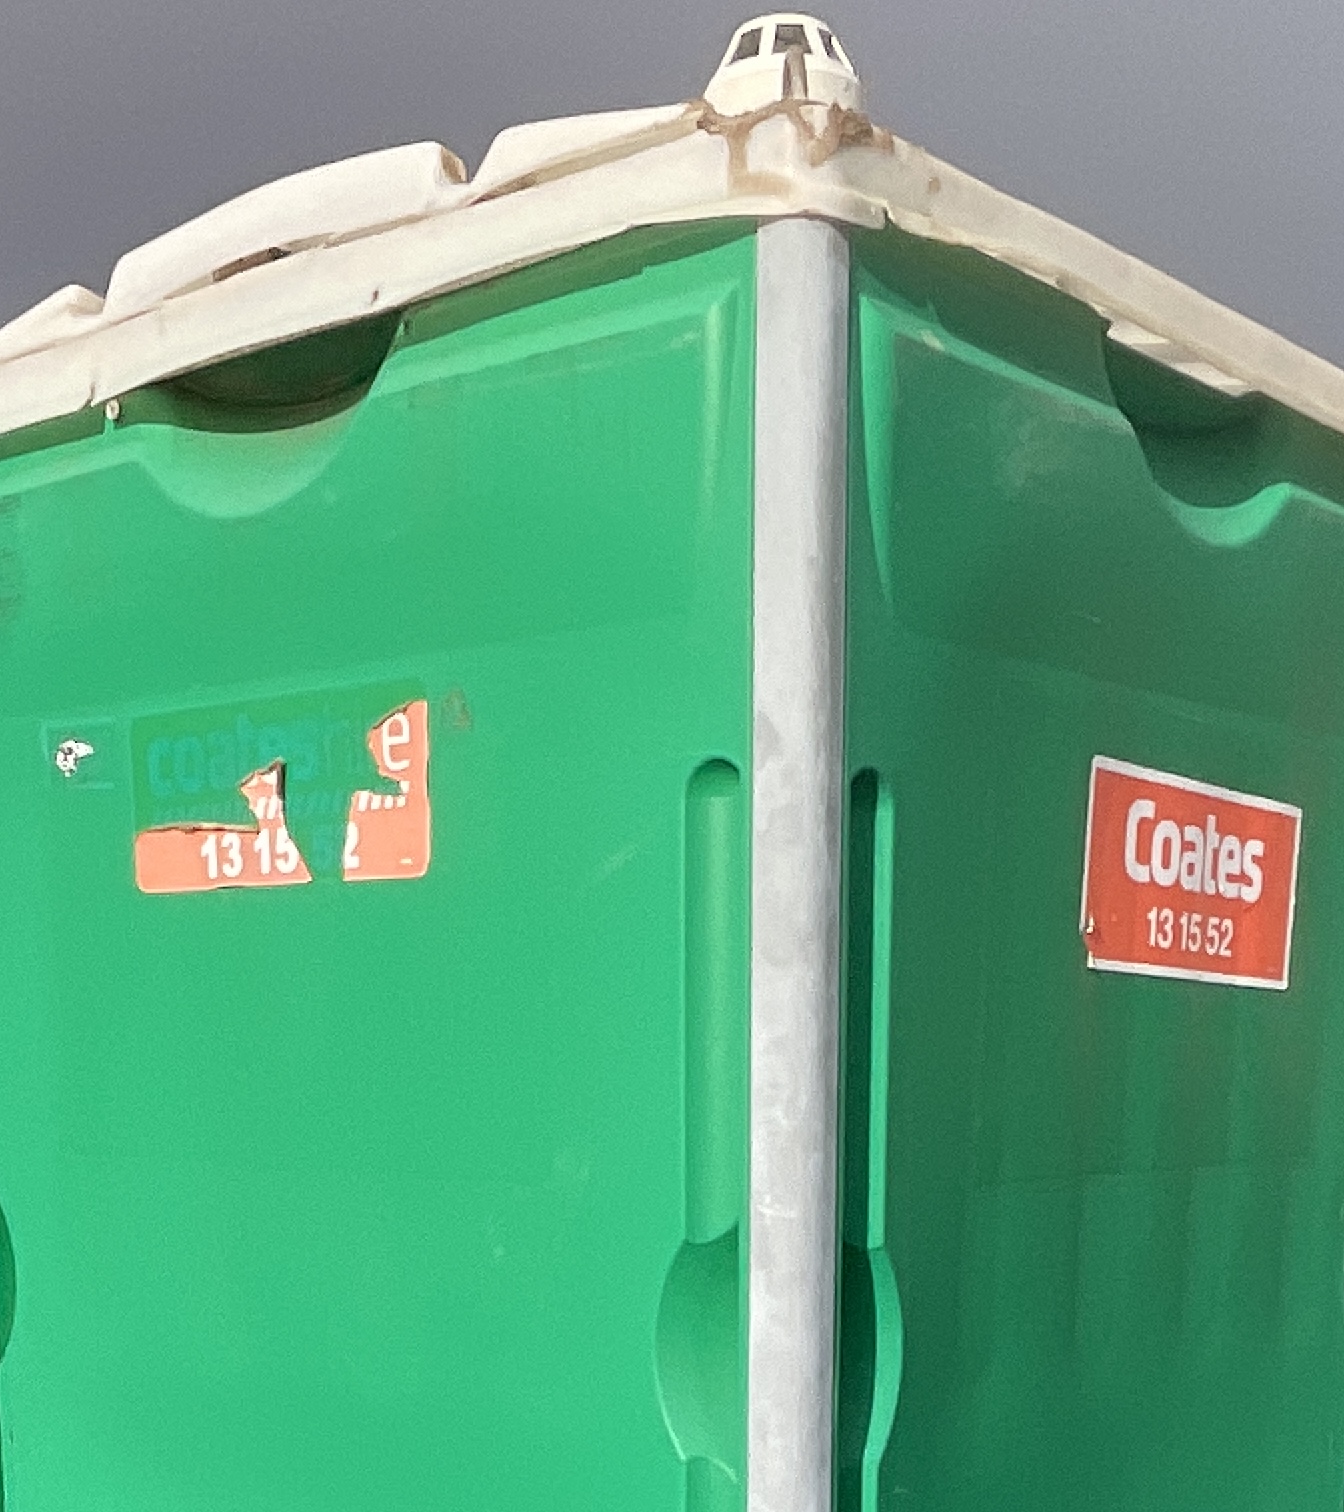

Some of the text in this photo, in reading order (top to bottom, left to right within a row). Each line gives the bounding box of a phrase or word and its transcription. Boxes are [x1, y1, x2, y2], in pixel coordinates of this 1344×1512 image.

[200, 833, 243, 879] 13
[254, 827, 299, 876] 15
[1124, 799, 1266, 903] Coates
[1147, 906, 1234, 957] 13 15 52
